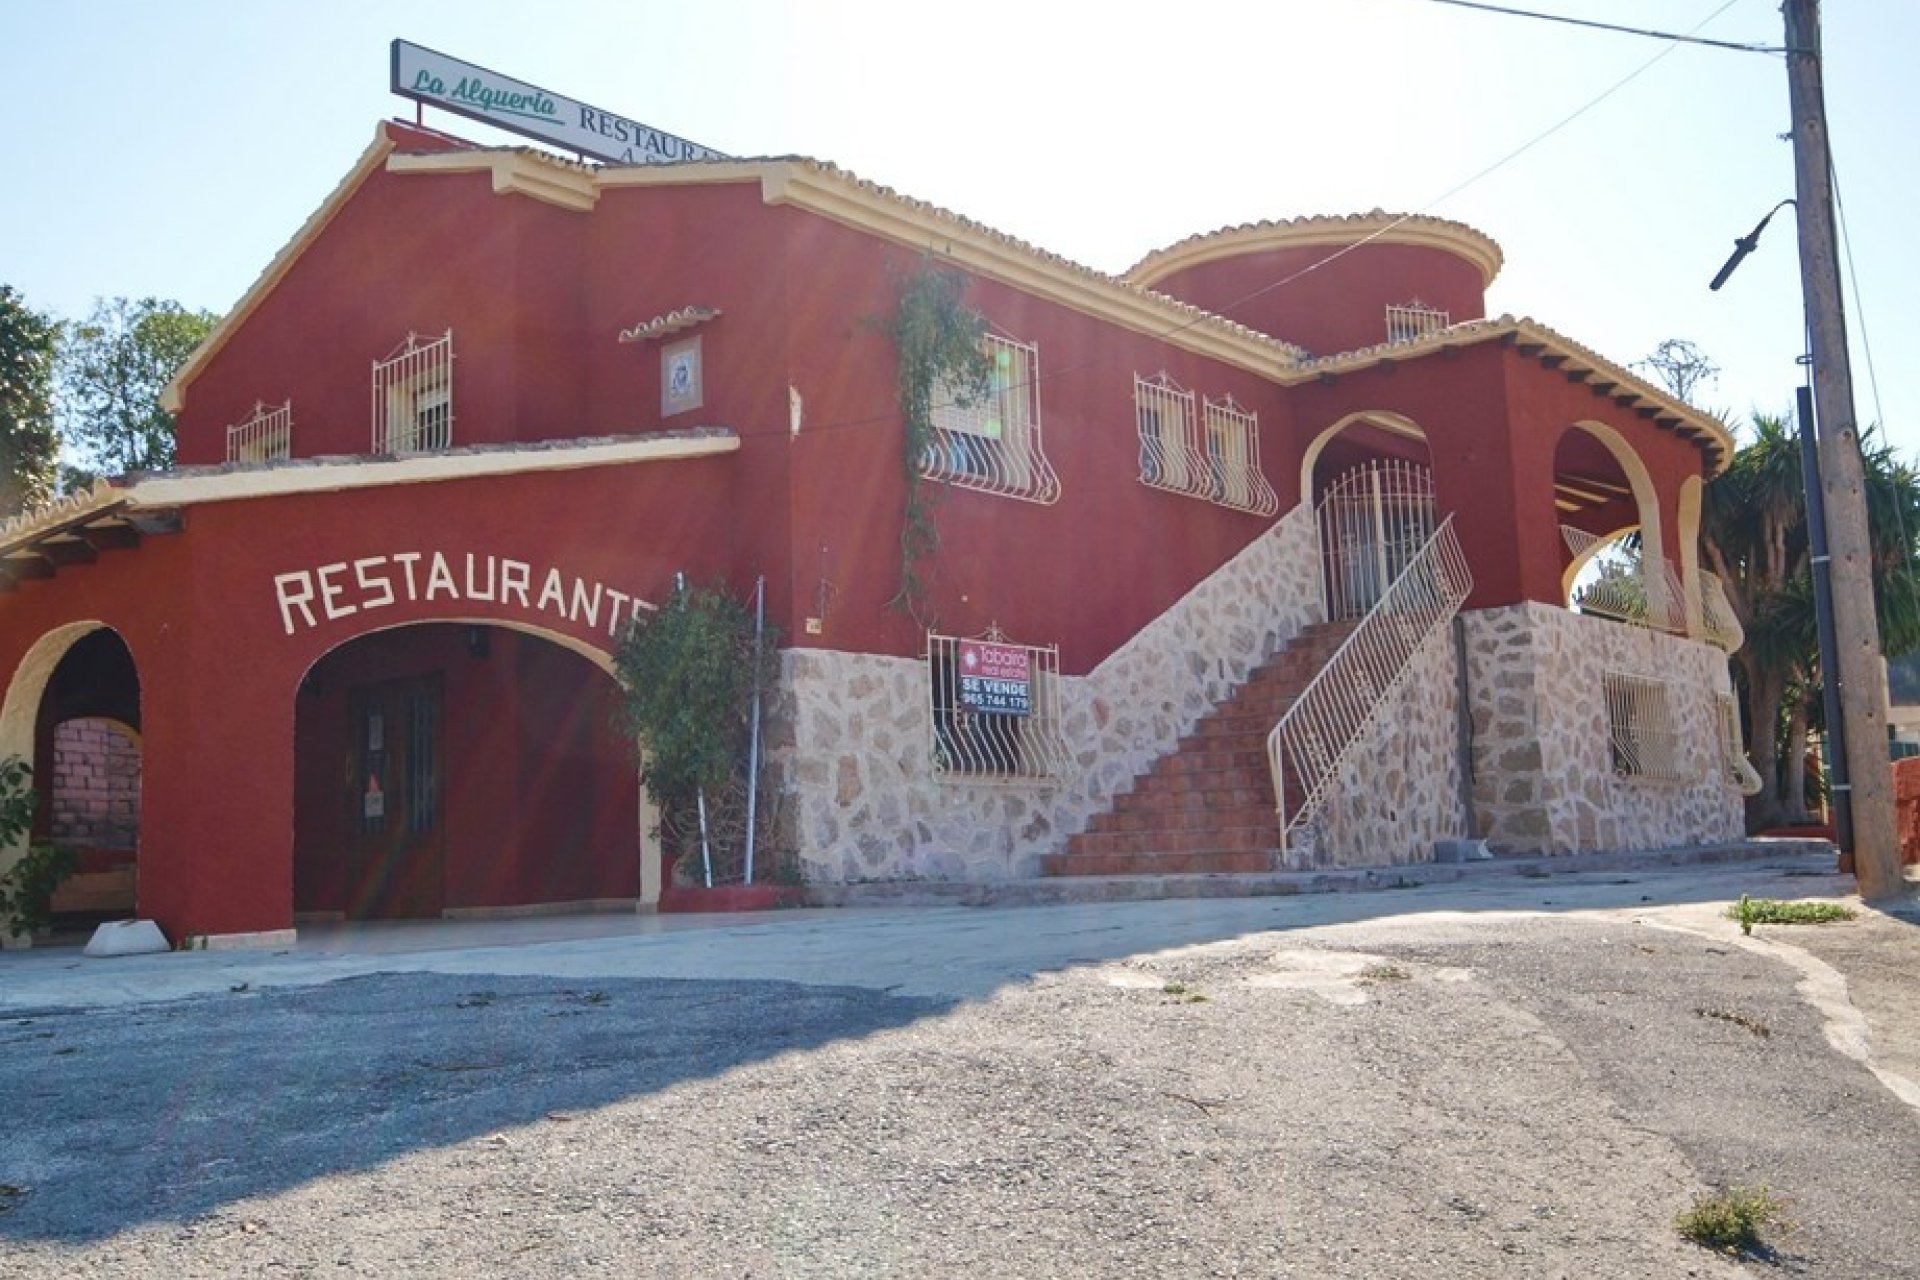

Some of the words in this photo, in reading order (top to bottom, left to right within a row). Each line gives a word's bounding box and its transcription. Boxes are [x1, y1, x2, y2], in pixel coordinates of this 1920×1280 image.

[411, 69, 446, 95] La
[963, 679, 980, 691] SE
[984, 680, 1027, 696] VENDE
